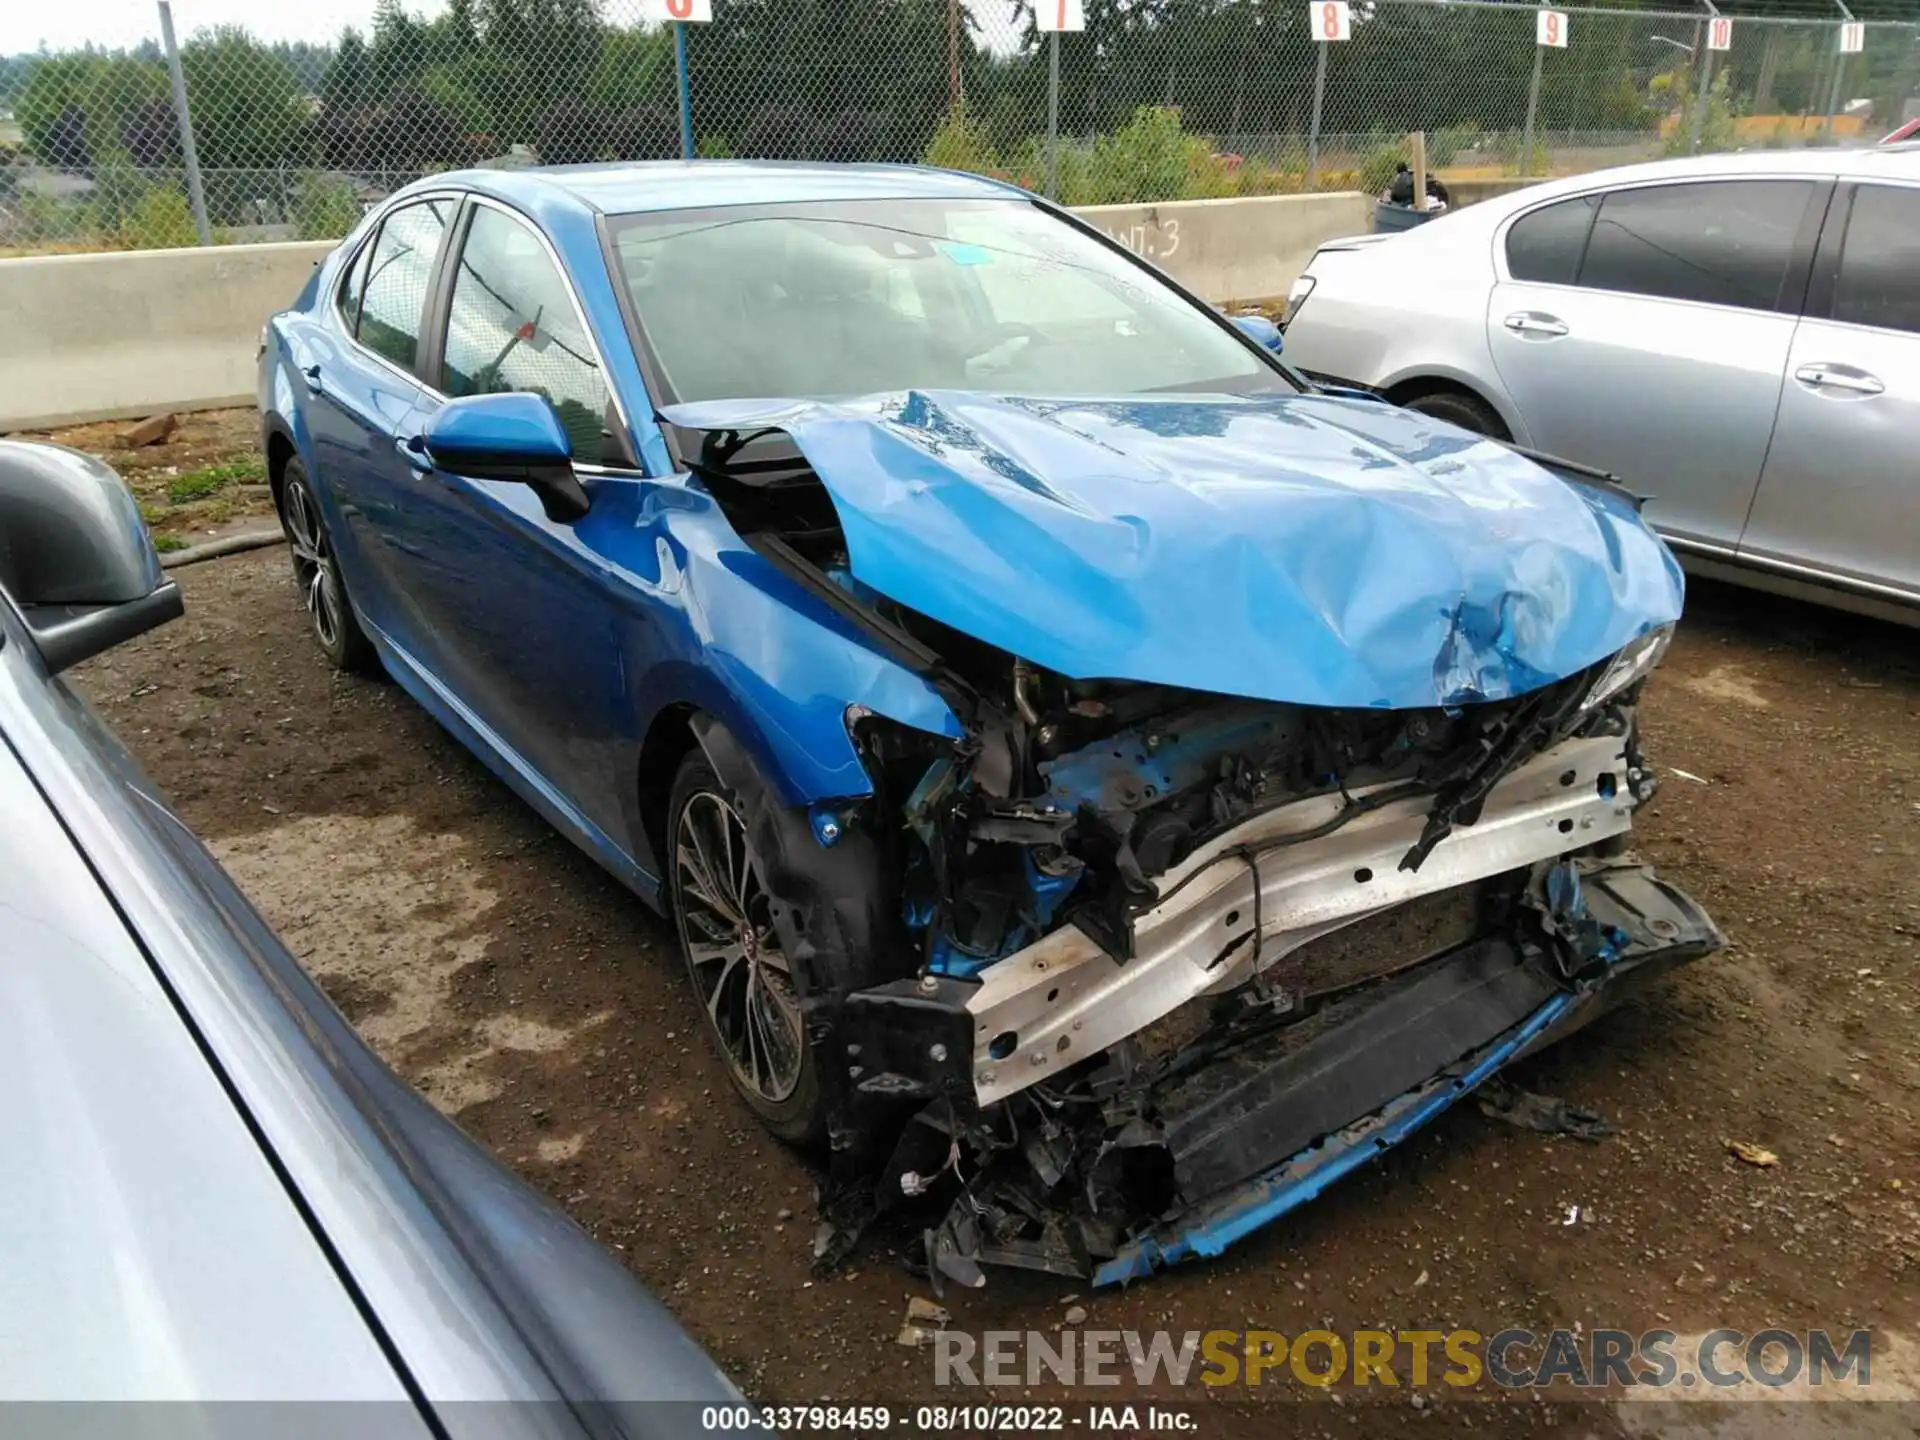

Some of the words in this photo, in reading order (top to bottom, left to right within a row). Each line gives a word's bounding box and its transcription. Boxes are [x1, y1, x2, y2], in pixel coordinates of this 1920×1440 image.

[1323, 3, 1339, 37] 8
[1547, 14, 1558, 43] 9
[1714, 20, 1728, 47] 10
[1847, 26, 1858, 50] 11
[1160, 219, 1180, 258] 3
